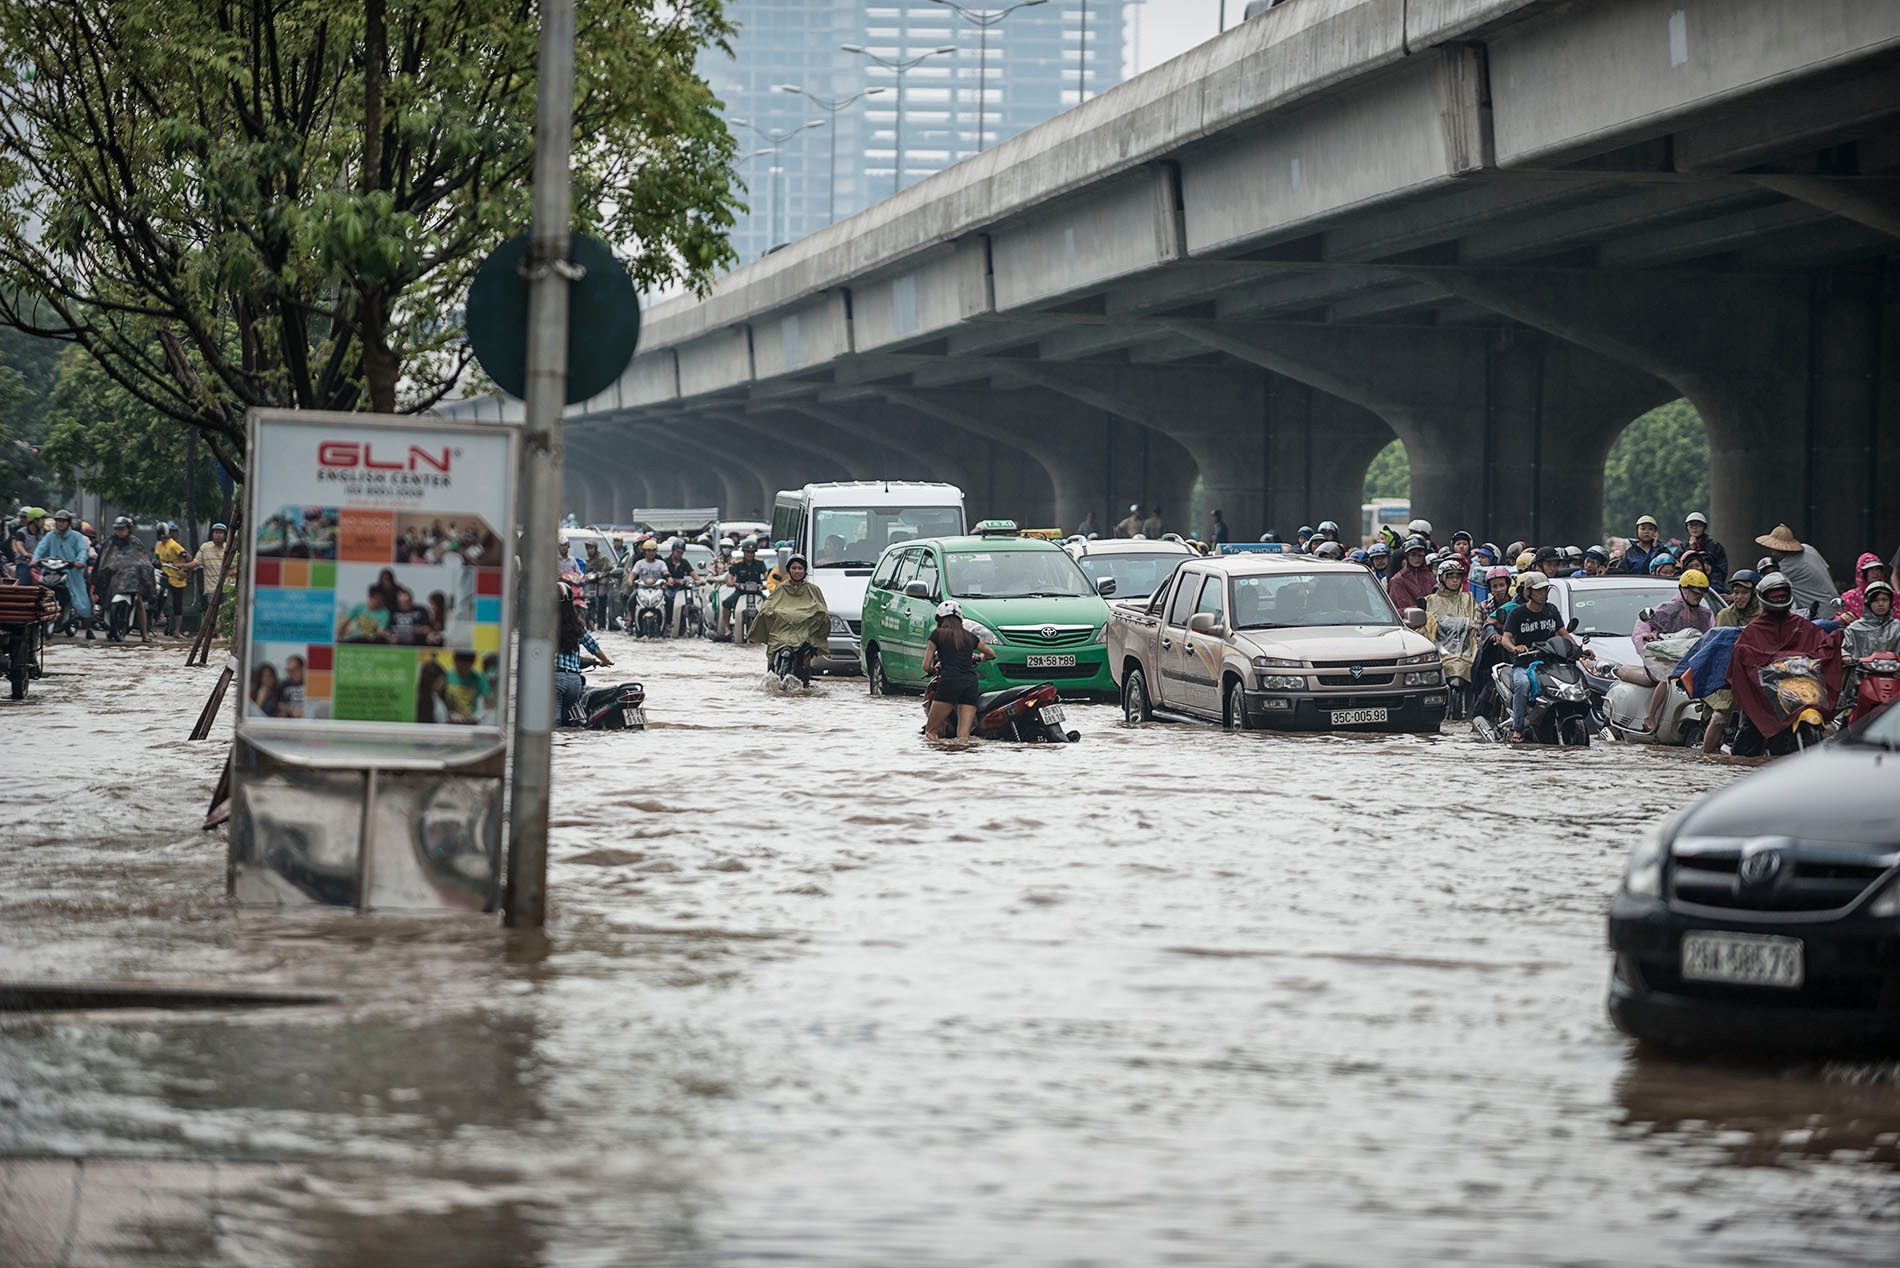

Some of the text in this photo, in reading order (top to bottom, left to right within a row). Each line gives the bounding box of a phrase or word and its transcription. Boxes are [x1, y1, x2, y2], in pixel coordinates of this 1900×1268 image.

[318, 440, 450, 473] GLN
[317, 469, 452, 488] ENGLISH CENTER
[985, 520, 1013, 528] TAXI
[1333, 710, 1387, 723] 35C-005.98
